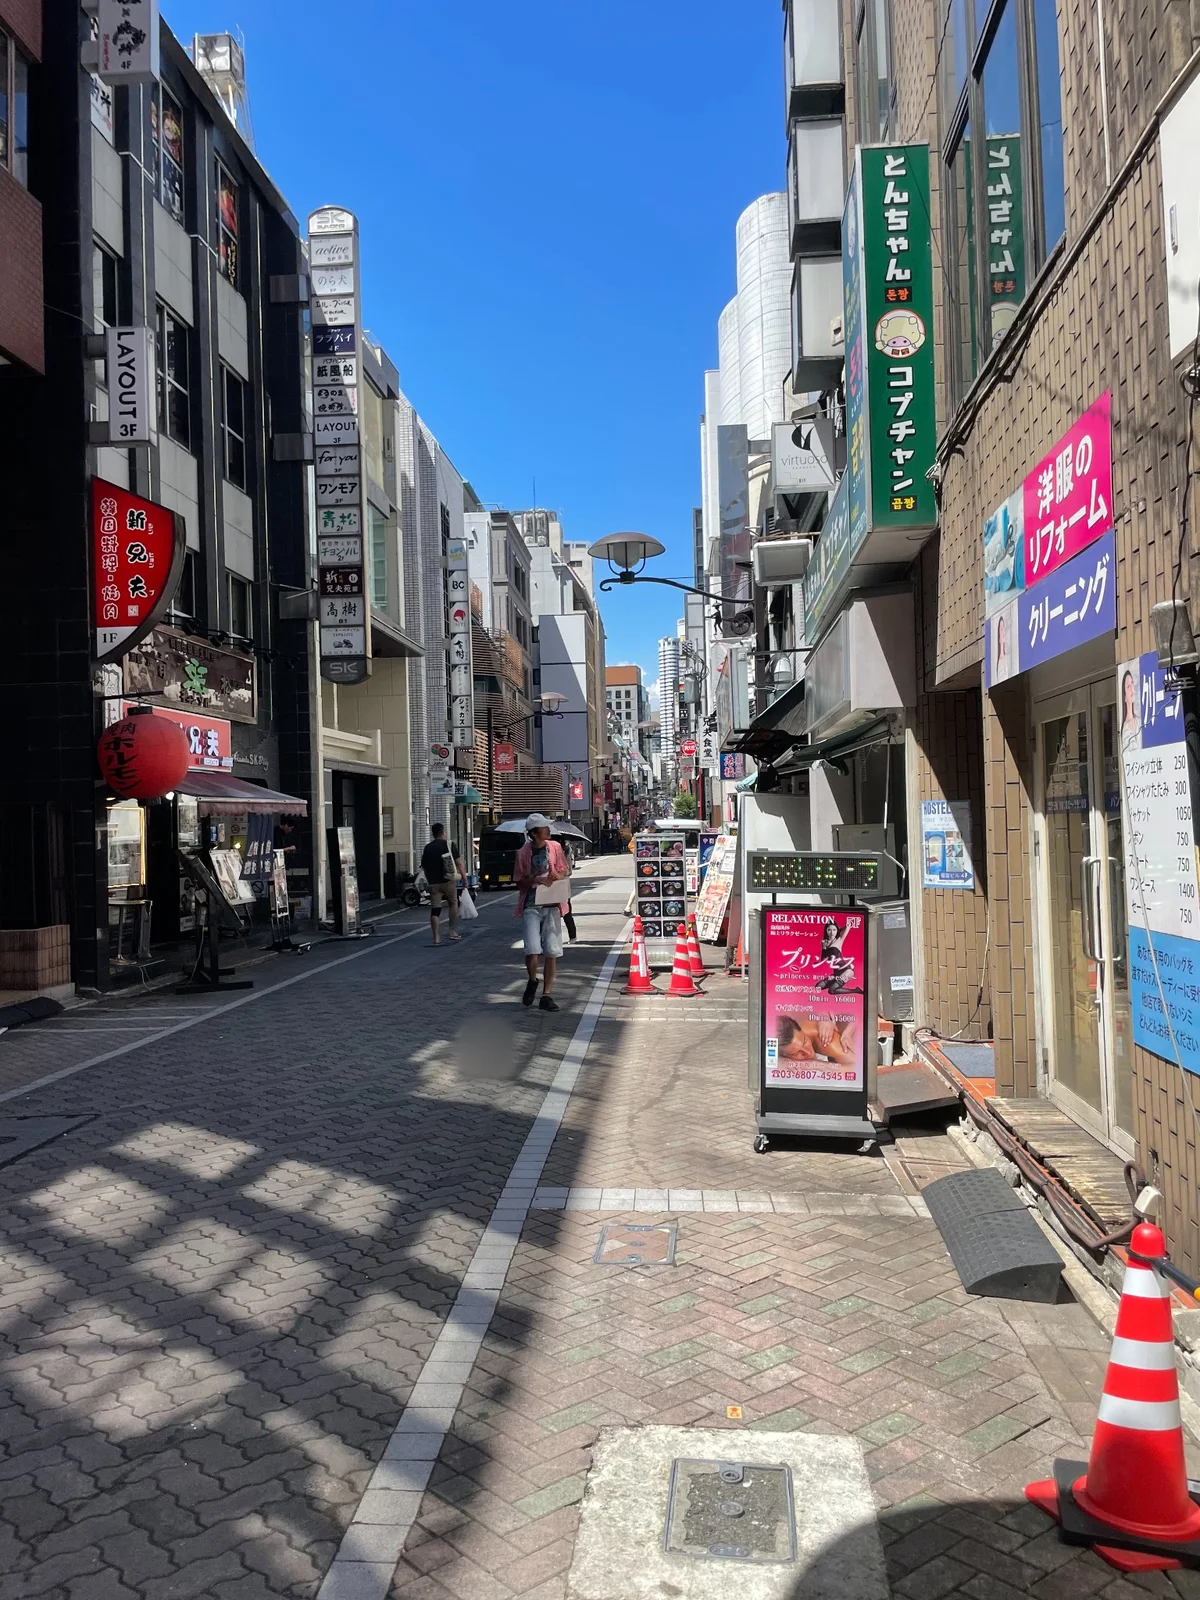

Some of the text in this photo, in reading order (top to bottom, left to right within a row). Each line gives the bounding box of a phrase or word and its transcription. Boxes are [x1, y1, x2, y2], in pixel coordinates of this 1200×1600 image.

[317, 211, 345, 223] SK
[883, 154, 912, 283] とんちゃん
[315, 244, 350, 255] active
[318, 275, 347, 286] のら犬
[316, 333, 352, 343] ララバイ
[117, 331, 137, 419] LAYOUT
[317, 364, 353, 377] 紙風船
[119, 424, 137, 437] 3F
[317, 422, 356, 432] LAYOUT
[889, 366, 916, 493] コプチャン
[318, 451, 358, 465] for you
[1037, 434, 1093, 520] 洋服の
[318, 482, 358, 494] ワンモア
[322, 510, 357, 528] 青松
[1029, 478, 1108, 575] リフォーム
[126, 508, 149, 598] 新兄夫
[325, 570, 338, 583] 新
[1028, 552, 1110, 648] クリーニング
[327, 602, 358, 617] 高樹
[102, 633, 118, 643] 1F
[329, 662, 358, 674] SK
[1125, 755, 1186, 777] ワイシャツ立体 250
[1175, 780, 1187, 796] 300
[923, 802, 952, 815] HOSTEL
[1176, 806, 1192, 821] 1050
[1177, 832, 1189, 847] 750
[1178, 857, 1190, 872] 750
[1179, 883, 1195, 899] 1400
[771, 914, 835, 925] RELAXATION
[1180, 908, 1192, 924] 750
[780, 947, 855, 969] プリンセス
[780, 1070, 842, 1081] 03-6807-4545
